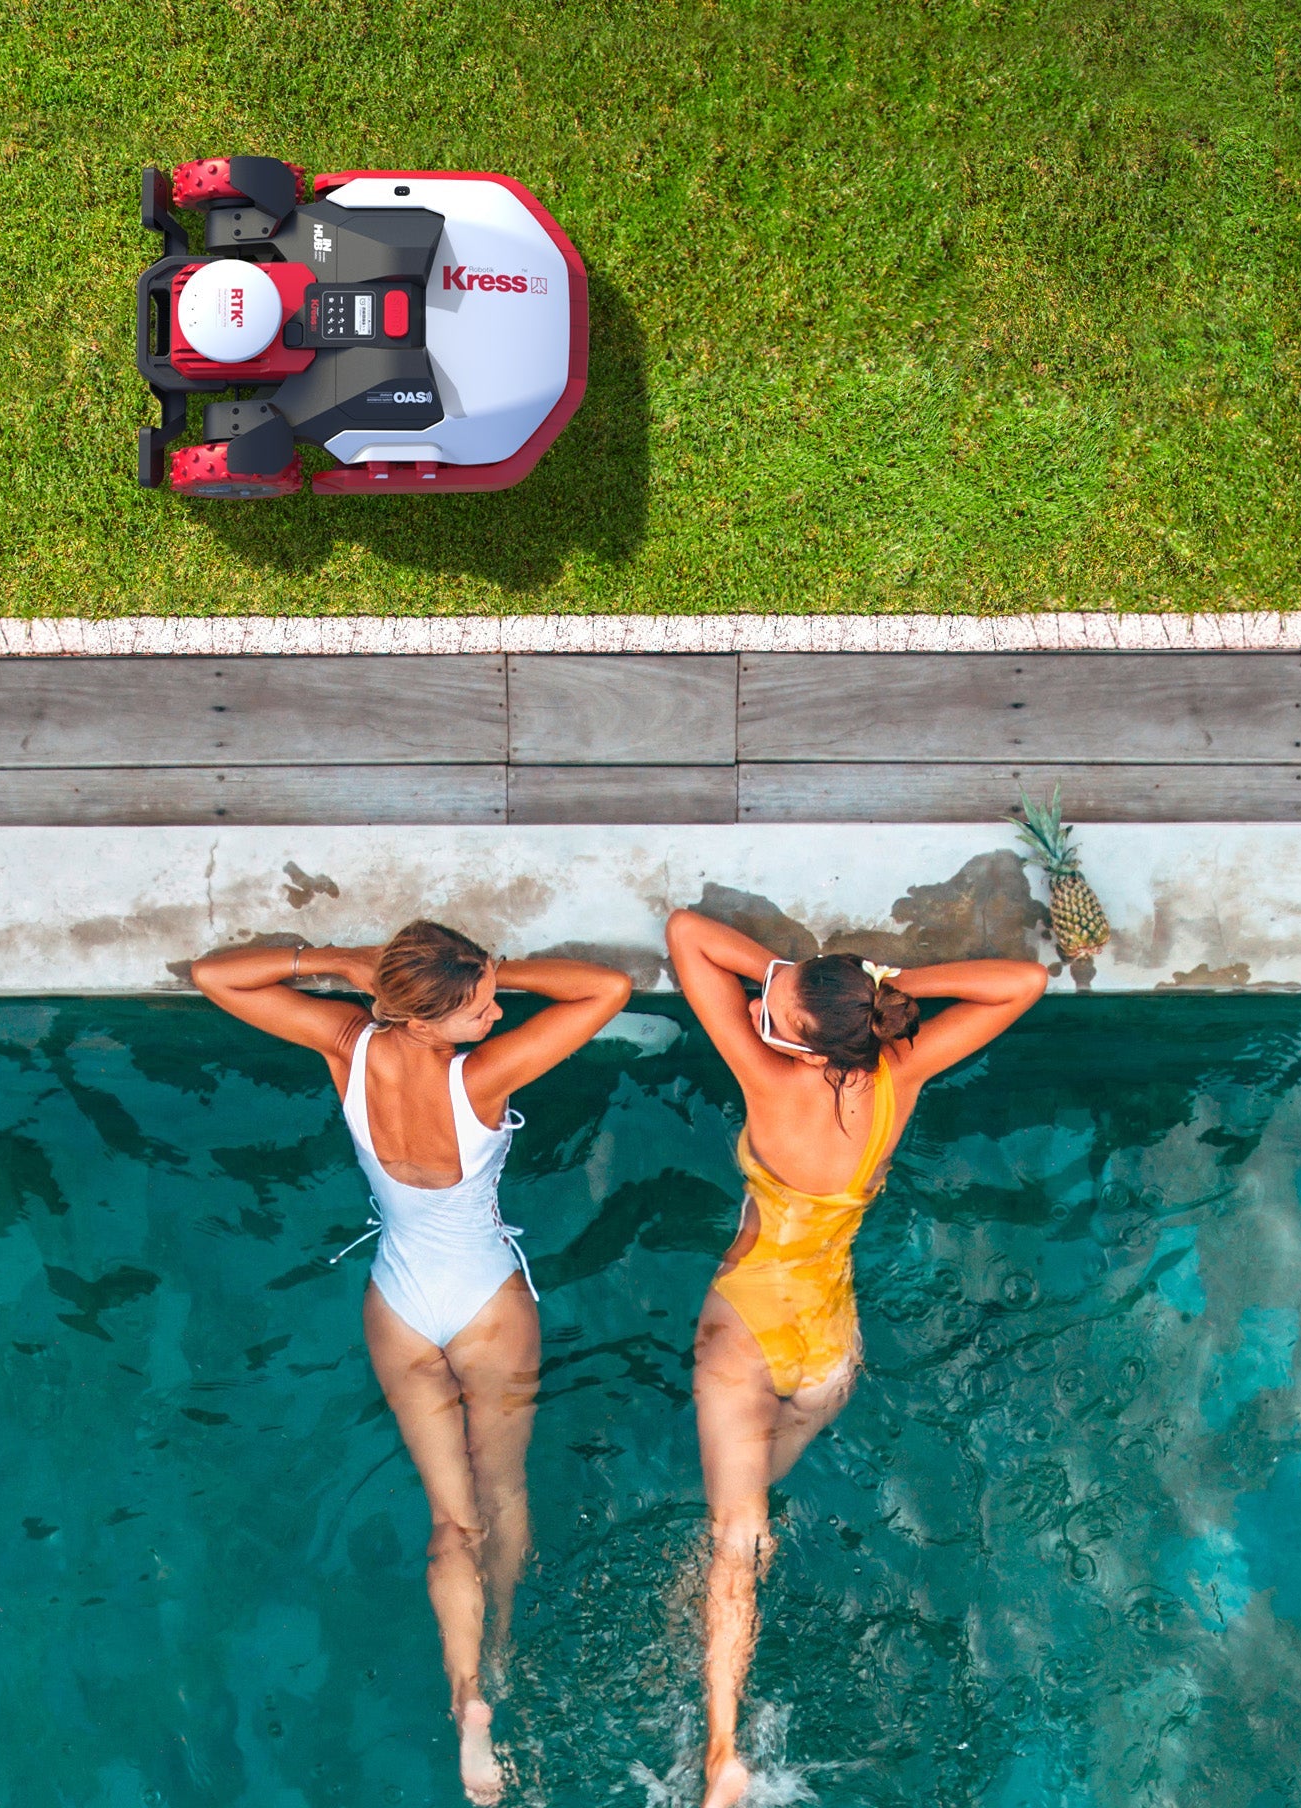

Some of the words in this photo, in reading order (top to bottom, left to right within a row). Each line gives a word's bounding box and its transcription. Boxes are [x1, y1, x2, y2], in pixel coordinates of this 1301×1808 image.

[313, 223, 324, 251] HUB
[442, 265, 529, 293] Kress
[468, 265, 495, 273] Robotik
[393, 391, 427, 404] OAS
